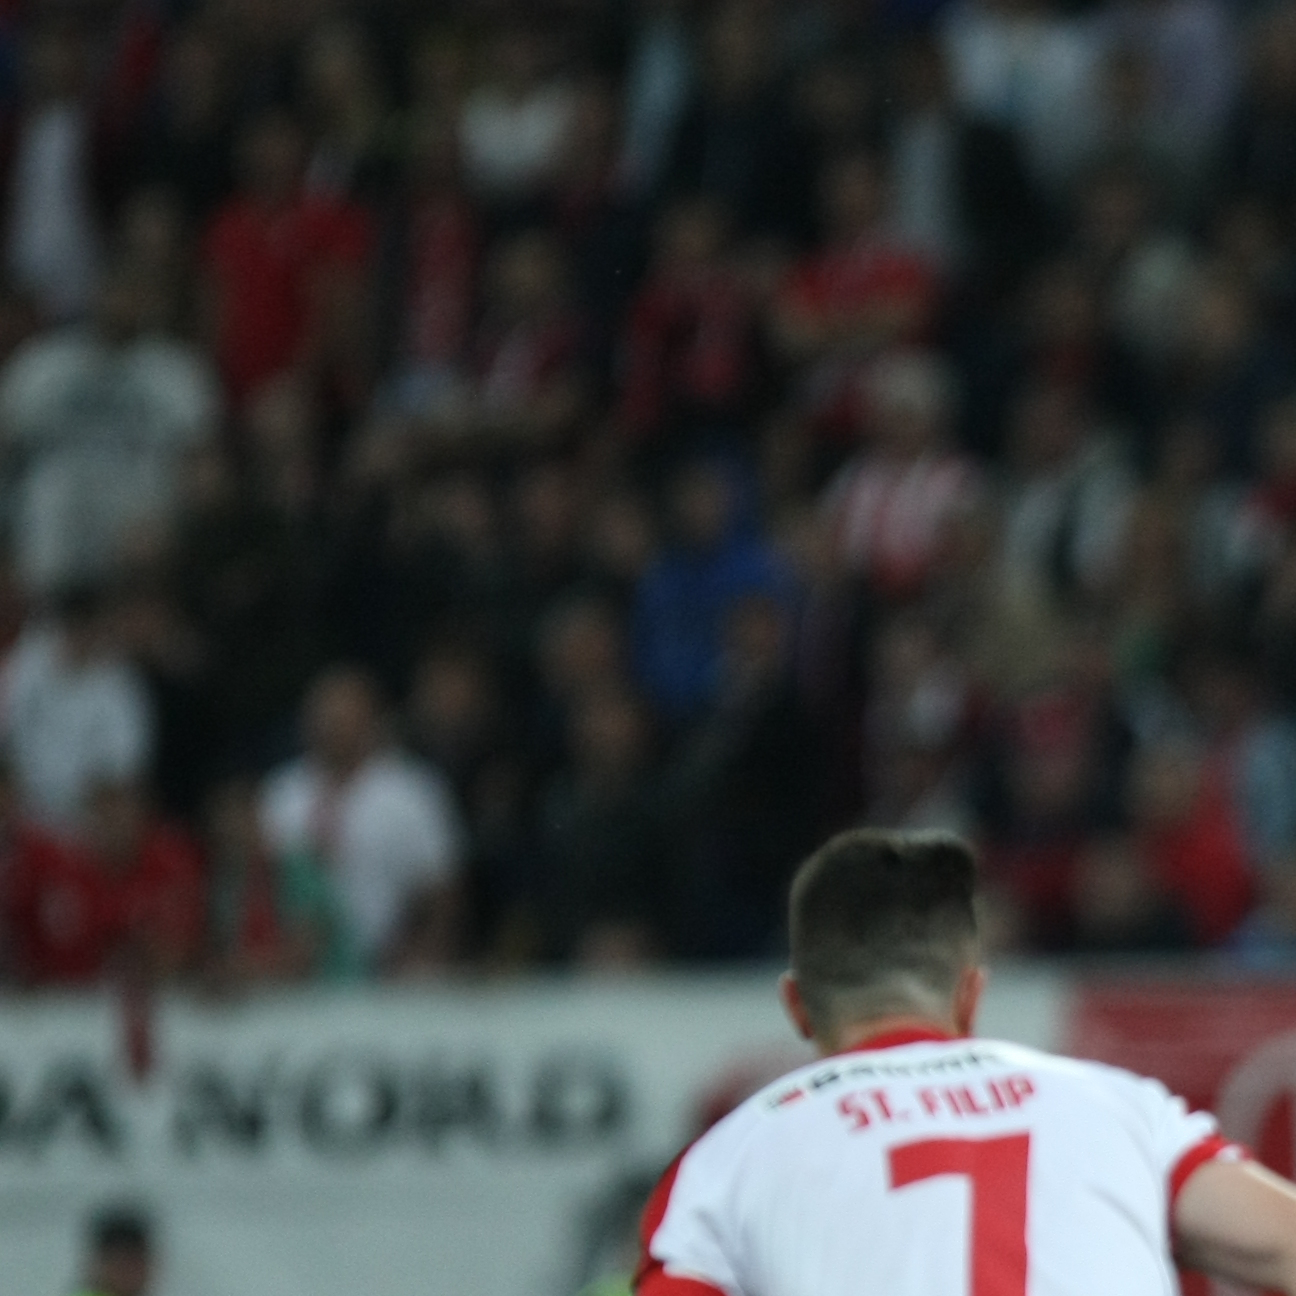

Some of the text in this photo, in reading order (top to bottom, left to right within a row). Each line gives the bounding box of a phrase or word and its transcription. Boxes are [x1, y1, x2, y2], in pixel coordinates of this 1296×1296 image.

[176, 1045, 634, 1154] NORD
[836, 1087, 909, 1132] ST.
[916, 1073, 1035, 1119] FILIP
